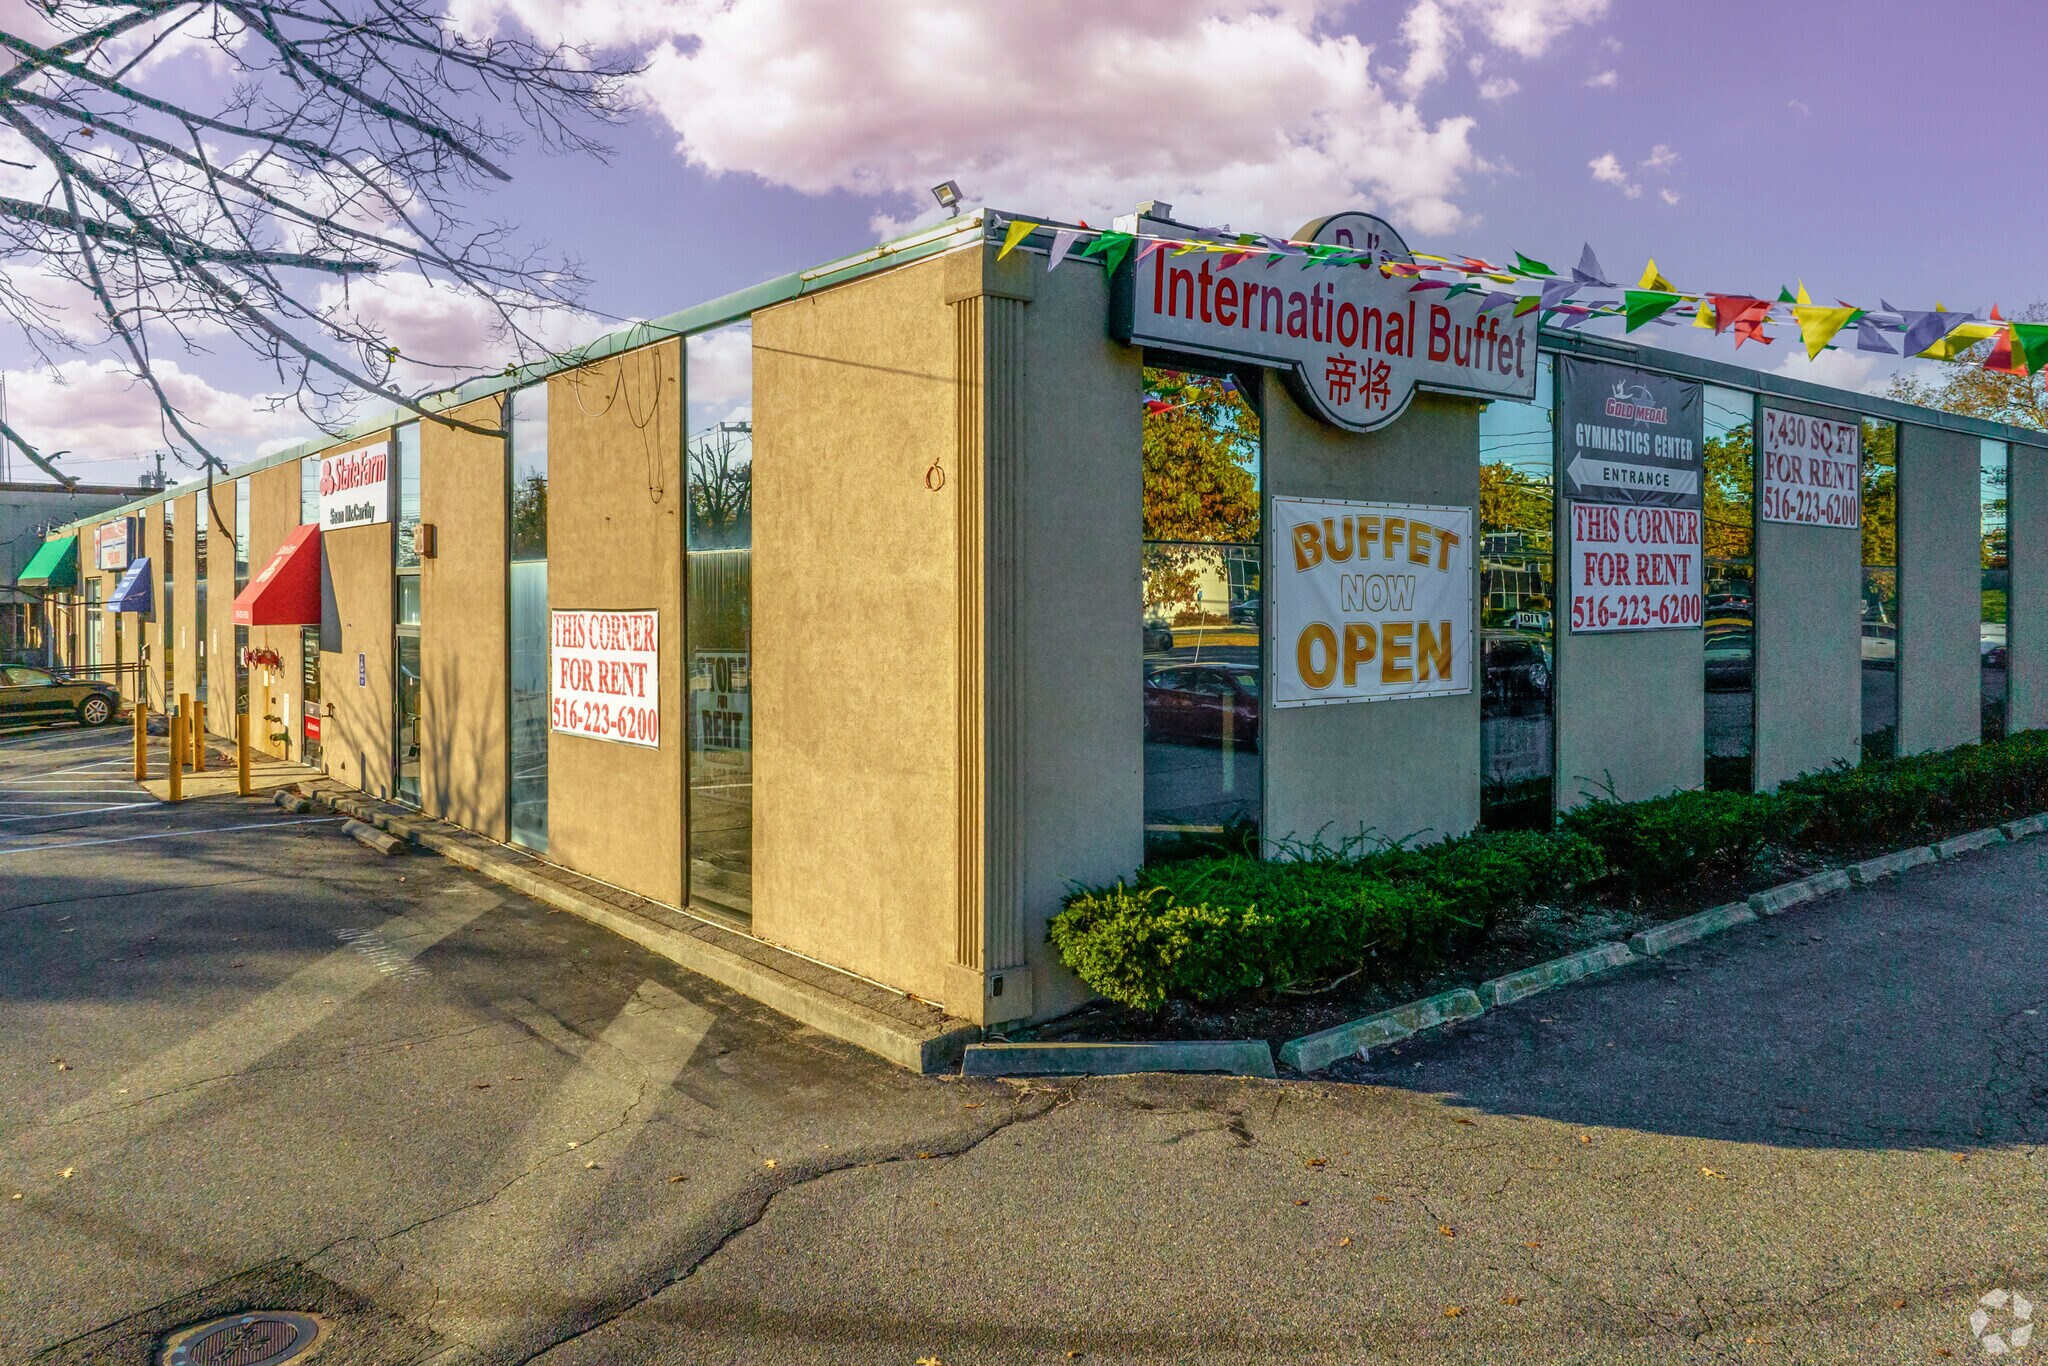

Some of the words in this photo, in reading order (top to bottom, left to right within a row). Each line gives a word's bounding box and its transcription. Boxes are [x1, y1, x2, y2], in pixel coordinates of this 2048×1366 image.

[1154, 248, 1415, 358] International
[1428, 303, 1525, 378] Buffet
[1325, 352, 1392, 411] 帝将
[1606, 397, 1634, 419] GOLD
[1634, 405, 1667, 424] MEDAL
[1576, 423, 1650, 455] GYMNASTICS
[1655, 435, 1692, 460] CENTER
[1767, 412, 1806, 449] 7,430
[1811, 420, 1833, 458] SQ
[1836, 426, 1855, 455] FT
[1603, 467, 1669, 487] ENTRANCE
[1765, 451, 1804, 484] FOR
[1808, 458, 1856, 491] RENT
[1574, 505, 1619, 543] THIS
[1624, 508, 1699, 544] CORNER
[1764, 486, 1857, 526] 516-223-6200
[1291, 514, 1461, 573] BUFFET
[1584, 552, 1631, 586] FOR
[1635, 553, 1691, 586] RENT
[1341, 574, 1415, 612] NOW
[1573, 593, 1700, 628] 516-223-6200
[554, 613, 585, 649] THIS
[589, 614, 655, 652] CORNER
[1296, 620, 1453, 690] OPEN
[560, 658, 594, 692] FOR
[598, 660, 648, 697] RENT
[553, 698, 658, 742] 516-223-6200
[702, 710, 743, 749] RENT
